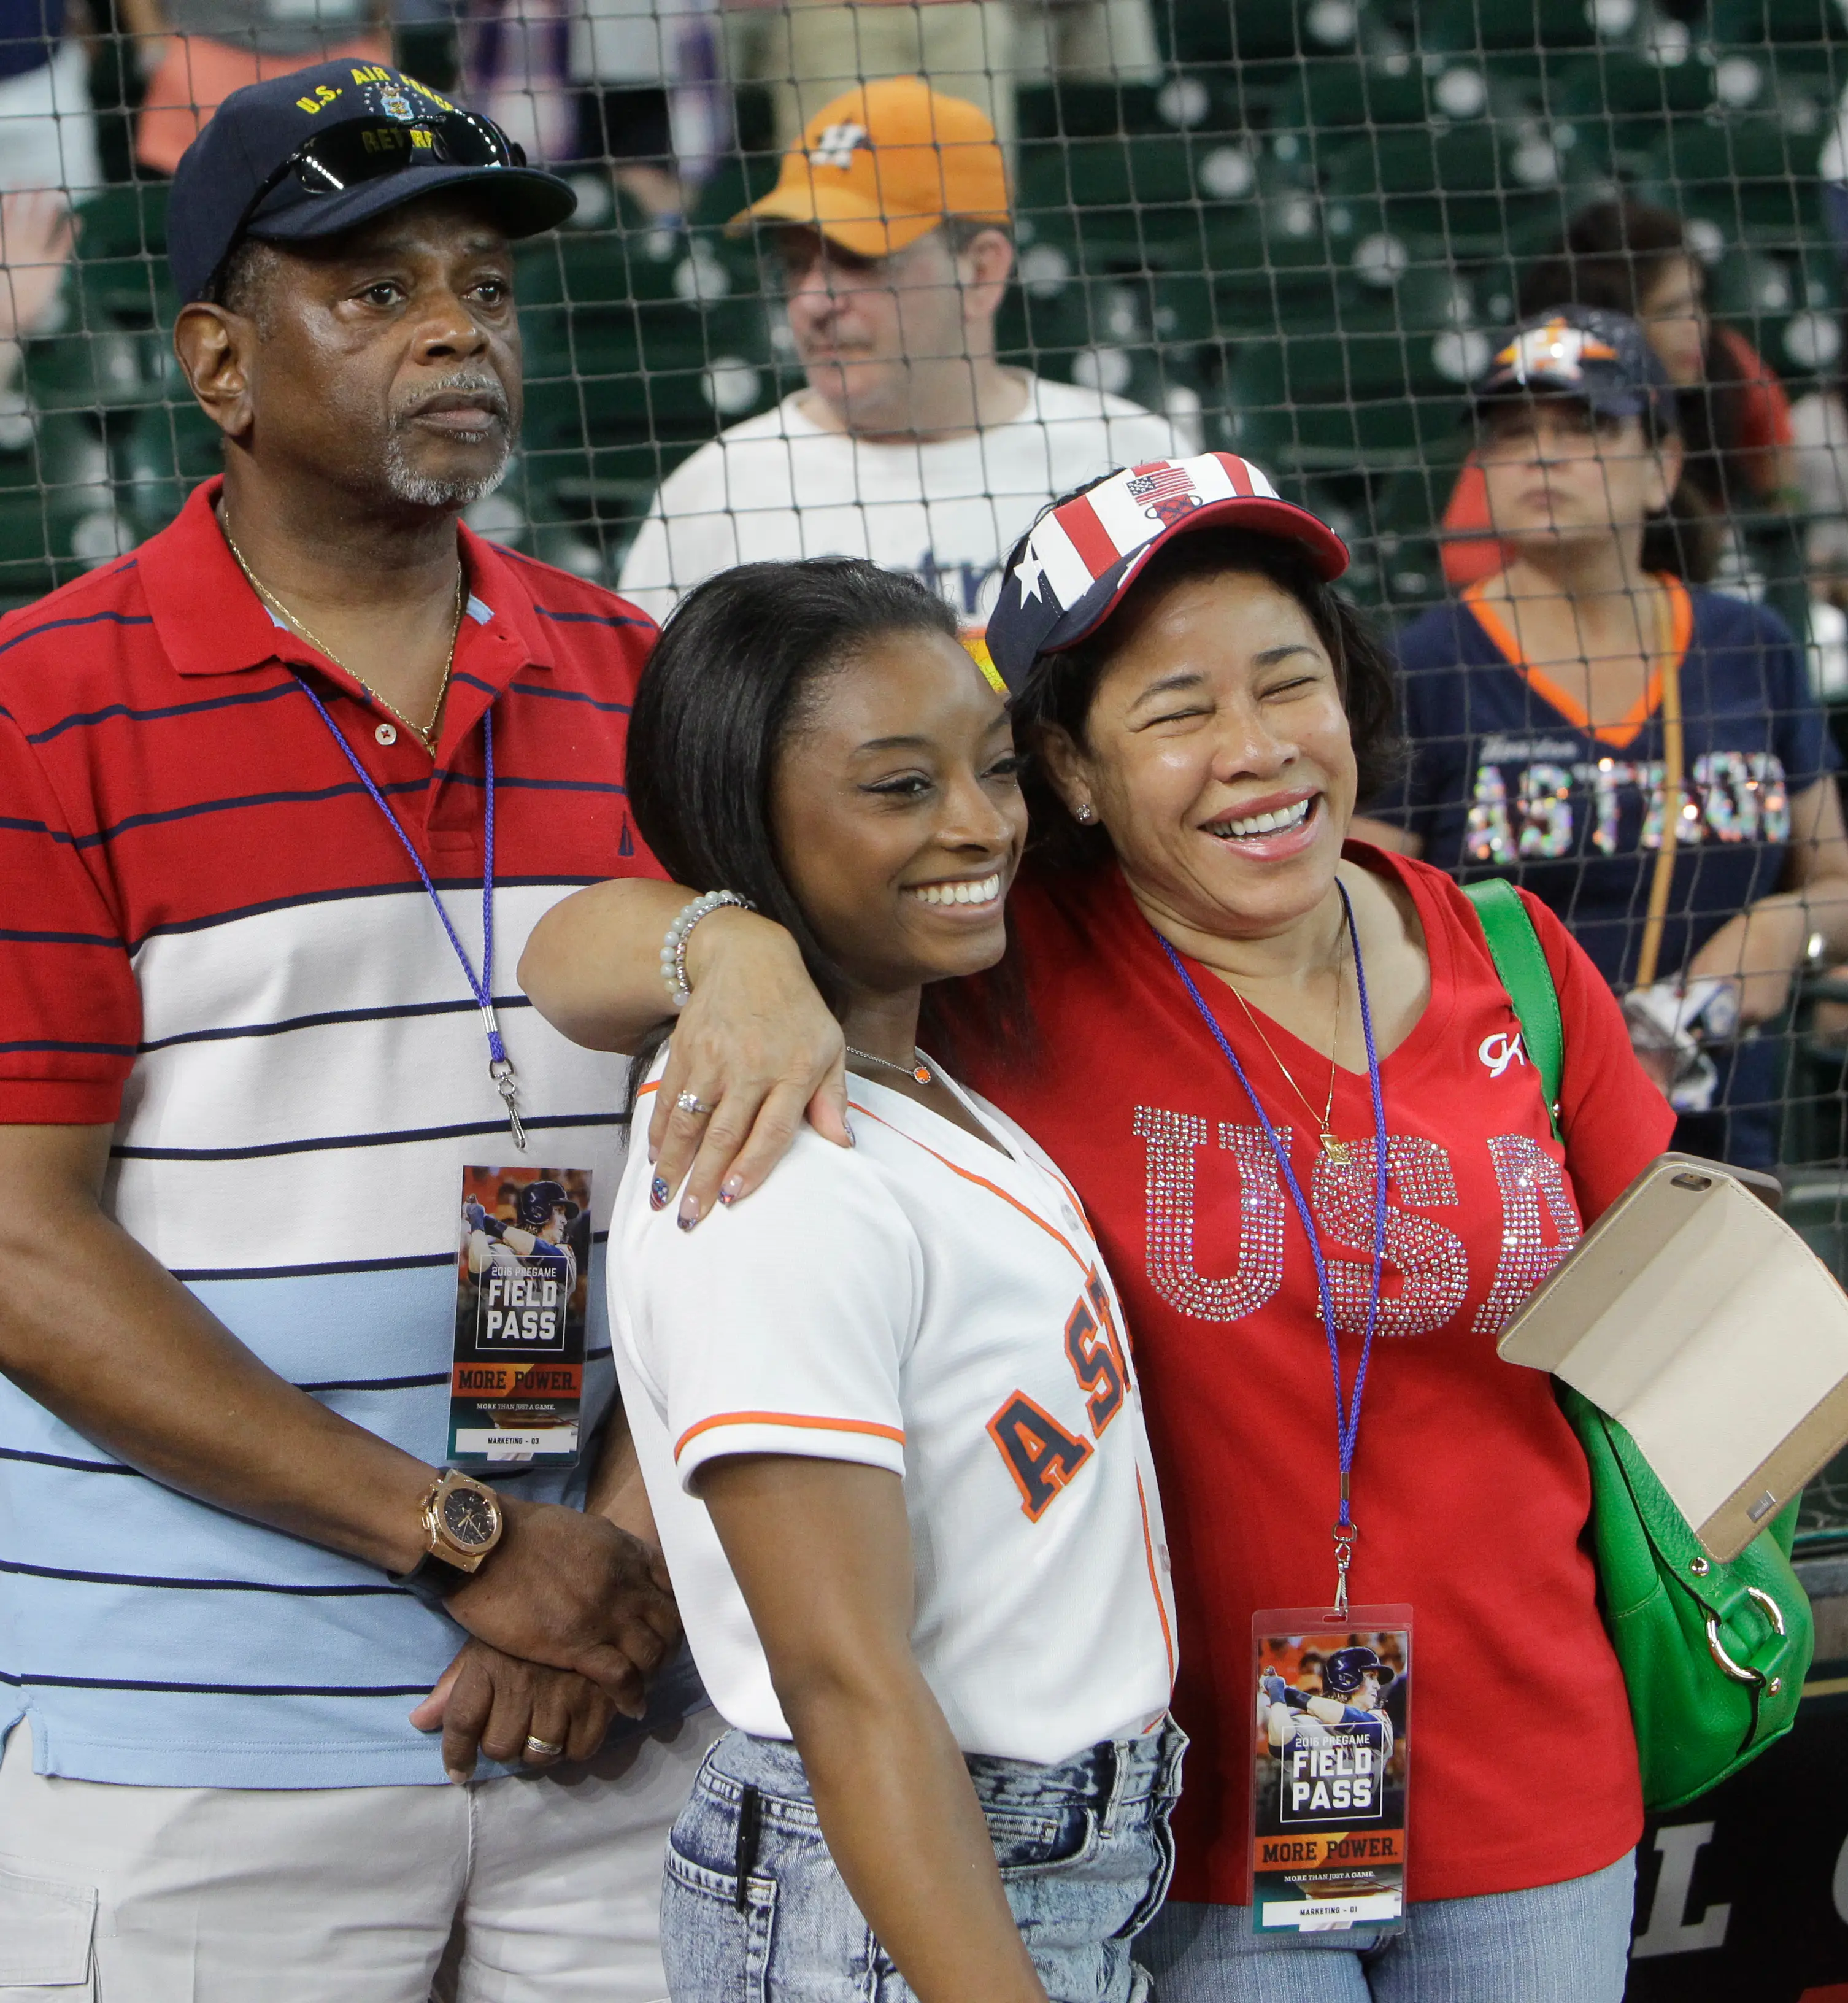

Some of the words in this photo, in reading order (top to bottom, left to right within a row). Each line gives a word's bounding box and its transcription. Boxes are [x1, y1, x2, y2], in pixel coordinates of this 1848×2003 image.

[296, 85, 342, 114] U.S.
[350, 66, 391, 85] AIR
[361, 127, 433, 153] RETR
[491, 1267, 512, 1276] 2016
[515, 1267, 556, 1277] PREGAME
[489, 1279, 557, 1307] FIELD
[487, 1310, 556, 1339] PASS
[459, 1370, 507, 1389] MORE
[515, 1371, 577, 1391] POWER.
[1295, 1737, 1319, 1748] 2016
[1323, 1734, 1371, 1746] PREGAME
[1293, 1747, 1371, 1778] FIELD
[1293, 1778, 1371, 1811] PASS
[1262, 1842, 1317, 1863] MORE
[1326, 1837, 1398, 1859] POWER.
[1300, 1907, 1340, 1915] MARKETING
